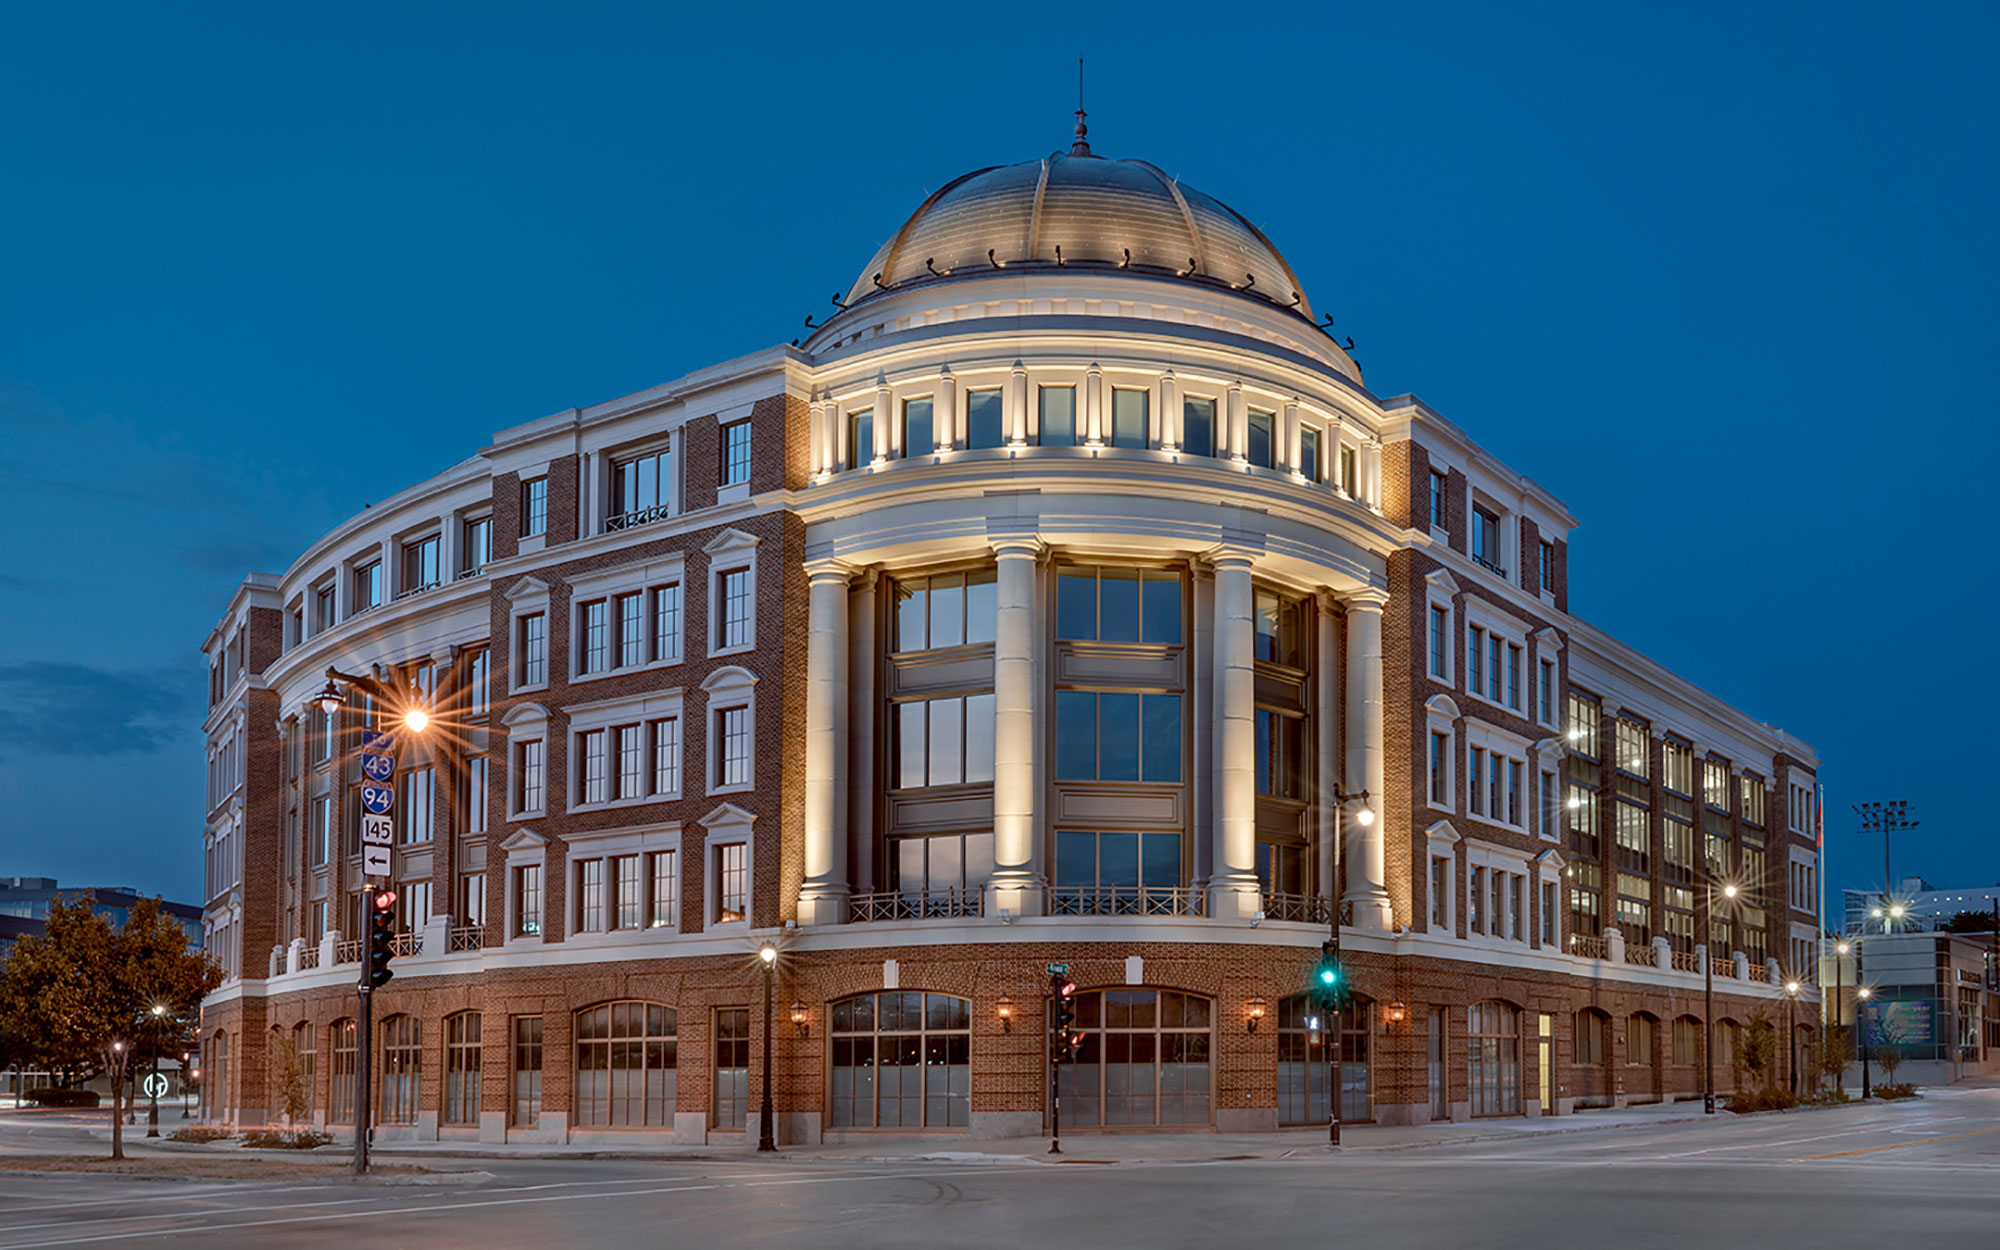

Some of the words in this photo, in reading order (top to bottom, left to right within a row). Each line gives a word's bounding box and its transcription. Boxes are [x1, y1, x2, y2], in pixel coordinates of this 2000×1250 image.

[366, 756, 390, 775] 43
[364, 788, 389, 808] 94
[365, 819, 391, 840] 145
